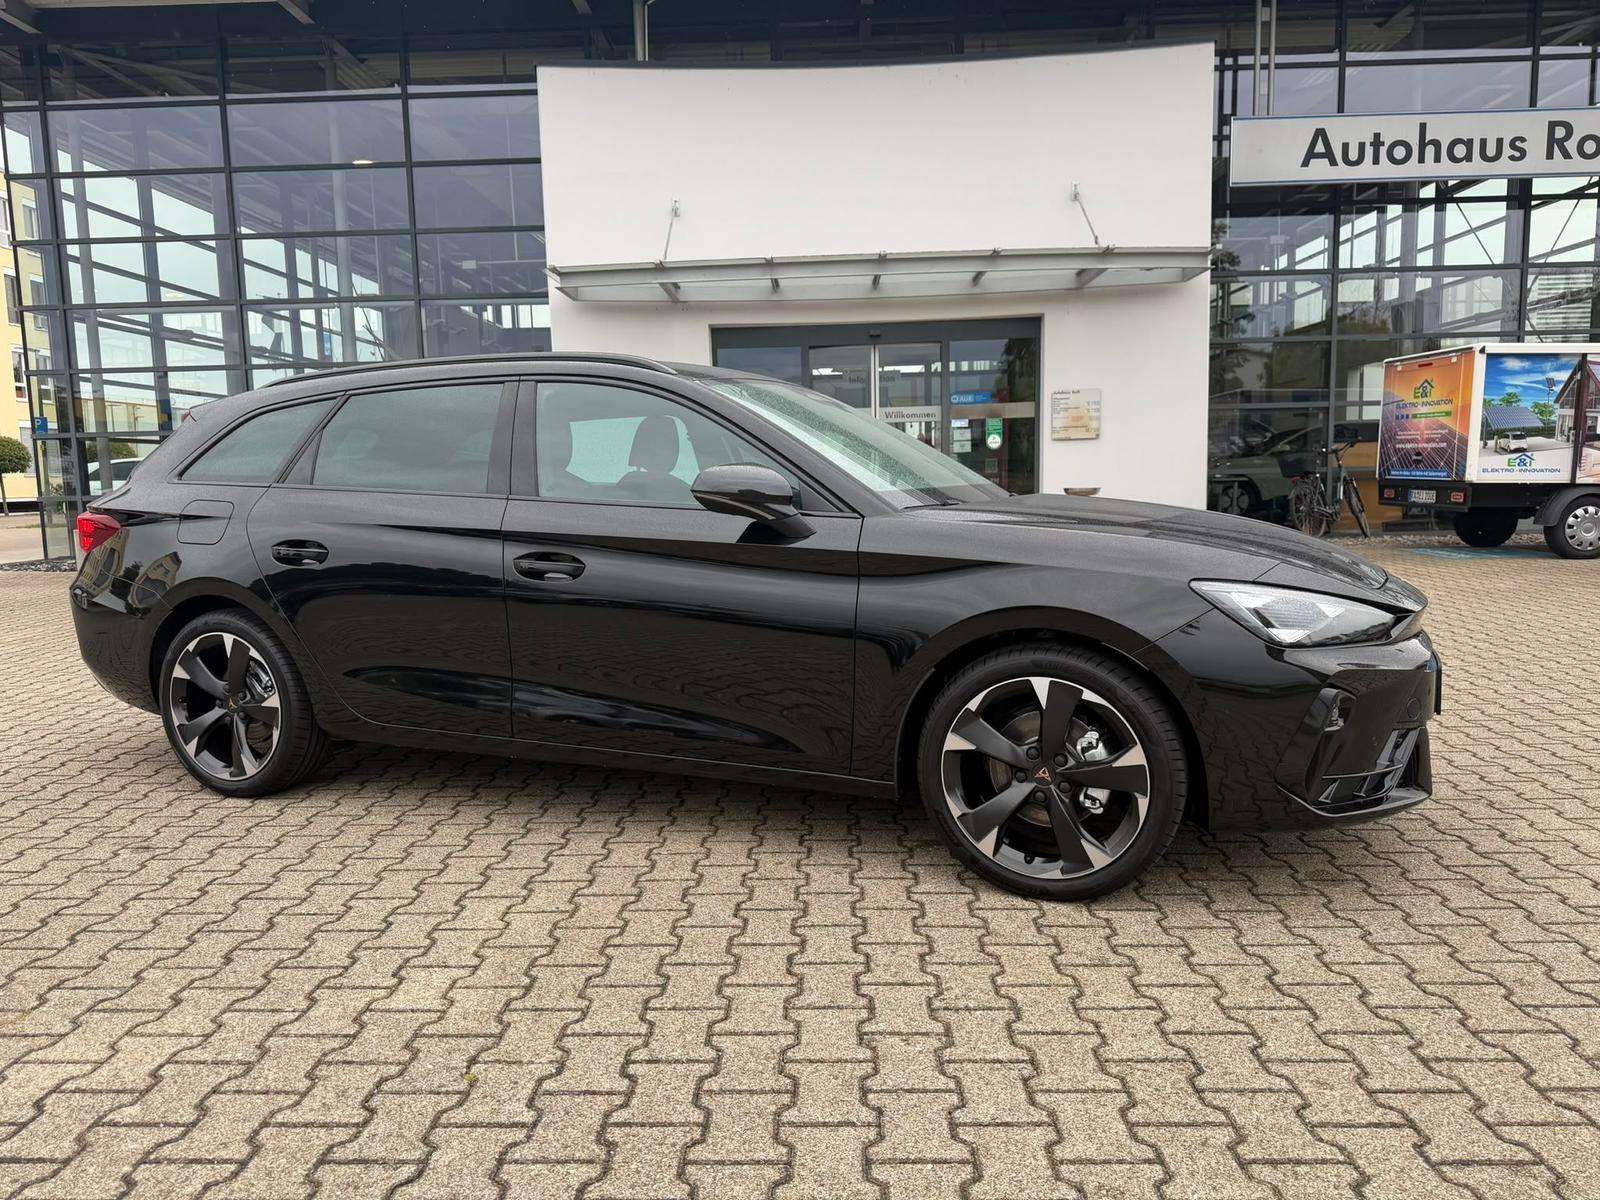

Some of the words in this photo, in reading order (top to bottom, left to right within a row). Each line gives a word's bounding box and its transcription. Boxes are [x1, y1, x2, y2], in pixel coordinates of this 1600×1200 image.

[1300, 122, 1527, 168] Autohaus
[1546, 120, 1600, 161] Ro
[884, 411, 936, 420] Willkommen
